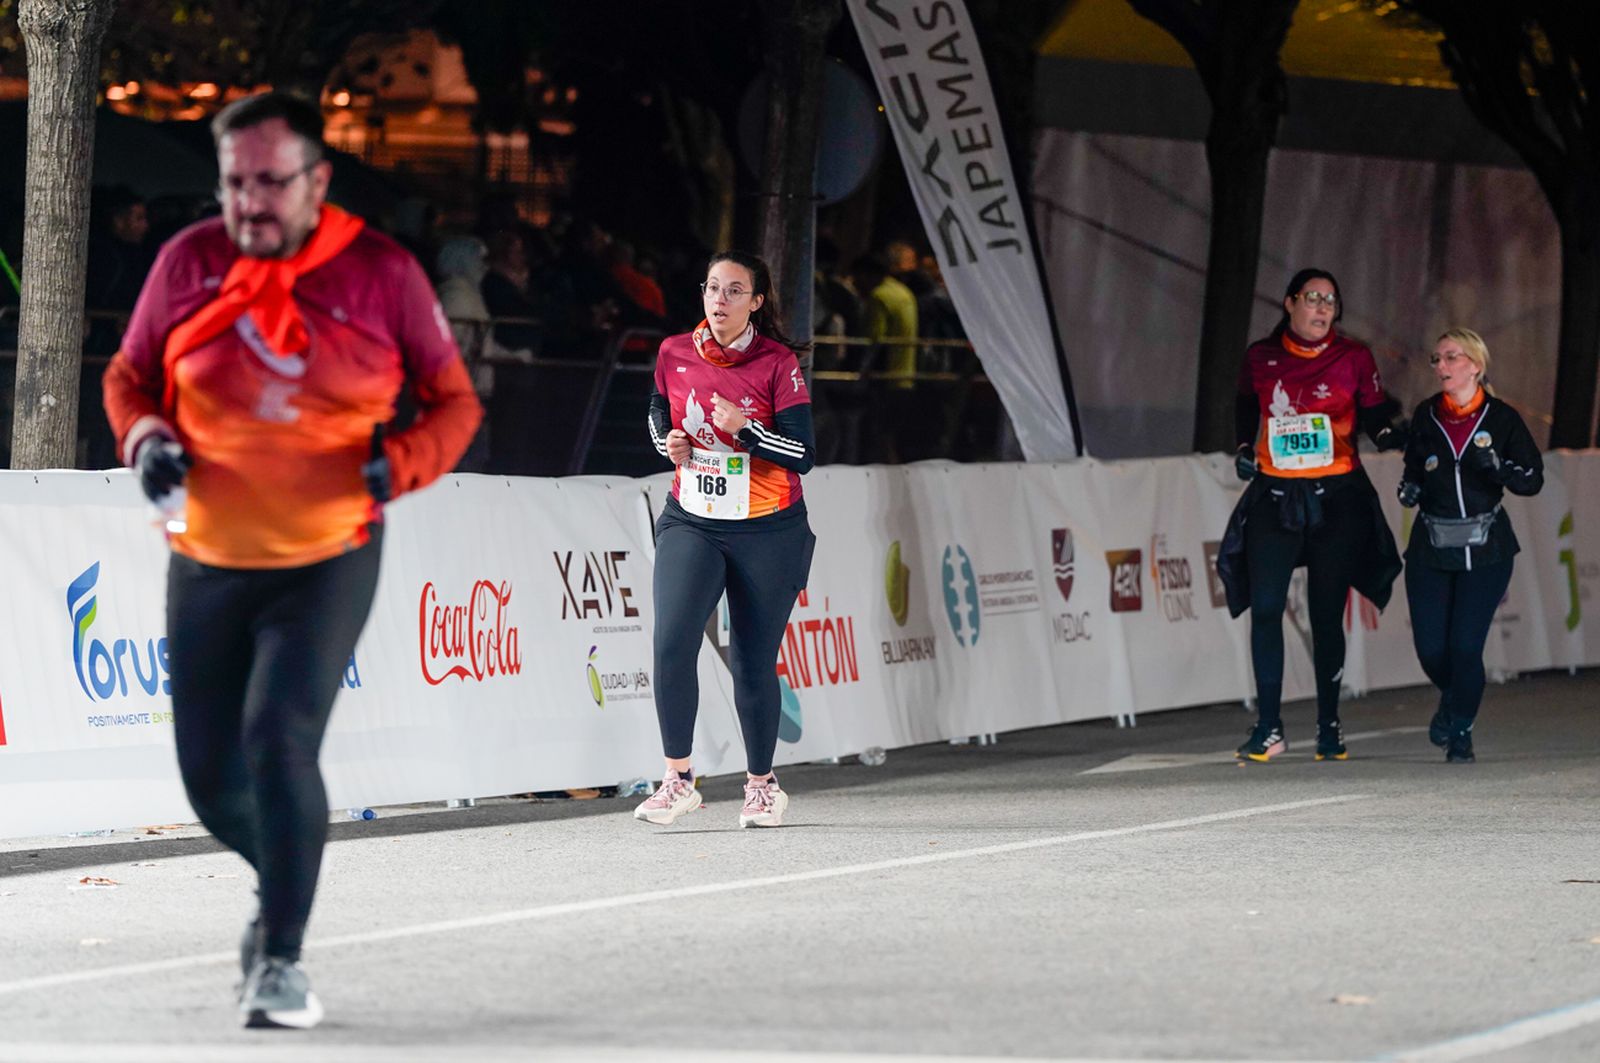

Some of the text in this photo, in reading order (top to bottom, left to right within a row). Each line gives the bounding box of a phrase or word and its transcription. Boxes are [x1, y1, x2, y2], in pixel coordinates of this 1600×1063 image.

[912, 0, 1023, 255] JAPEMAS
[696, 427, 715, 446] 43
[1281, 432, 1318, 452] 7951
[695, 474, 727, 496] 168
[420, 579, 522, 686] Coca-Cola
[88, 712, 150, 727] POSITIVAMENTE
